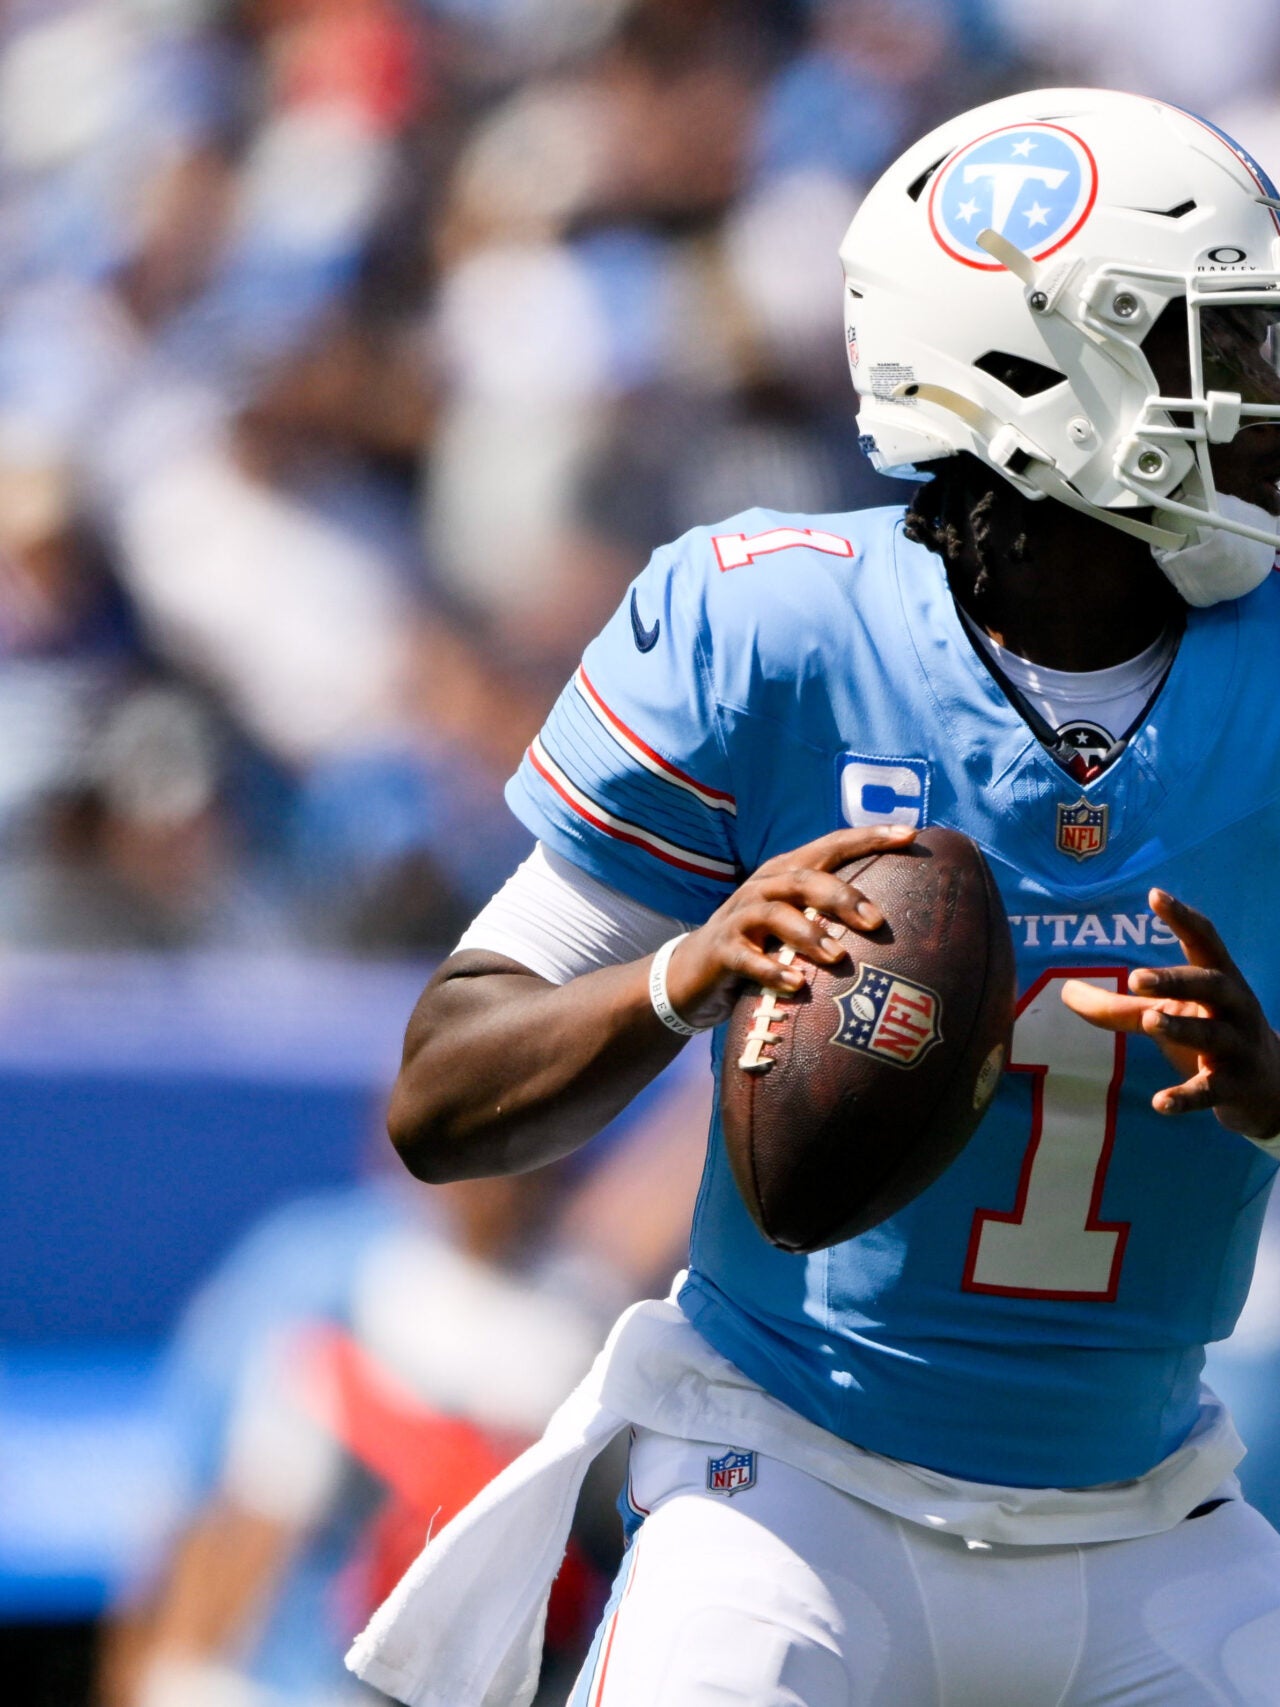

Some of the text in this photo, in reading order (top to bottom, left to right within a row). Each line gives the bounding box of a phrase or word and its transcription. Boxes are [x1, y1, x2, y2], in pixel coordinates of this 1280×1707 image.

[711, 528, 855, 573] 1
[841, 762, 921, 828] C
[1063, 827, 1099, 851] NFL
[872, 991, 933, 1061] NFL
[961, 967, 1131, 1302] 1
[713, 1467, 748, 1488] NFL
